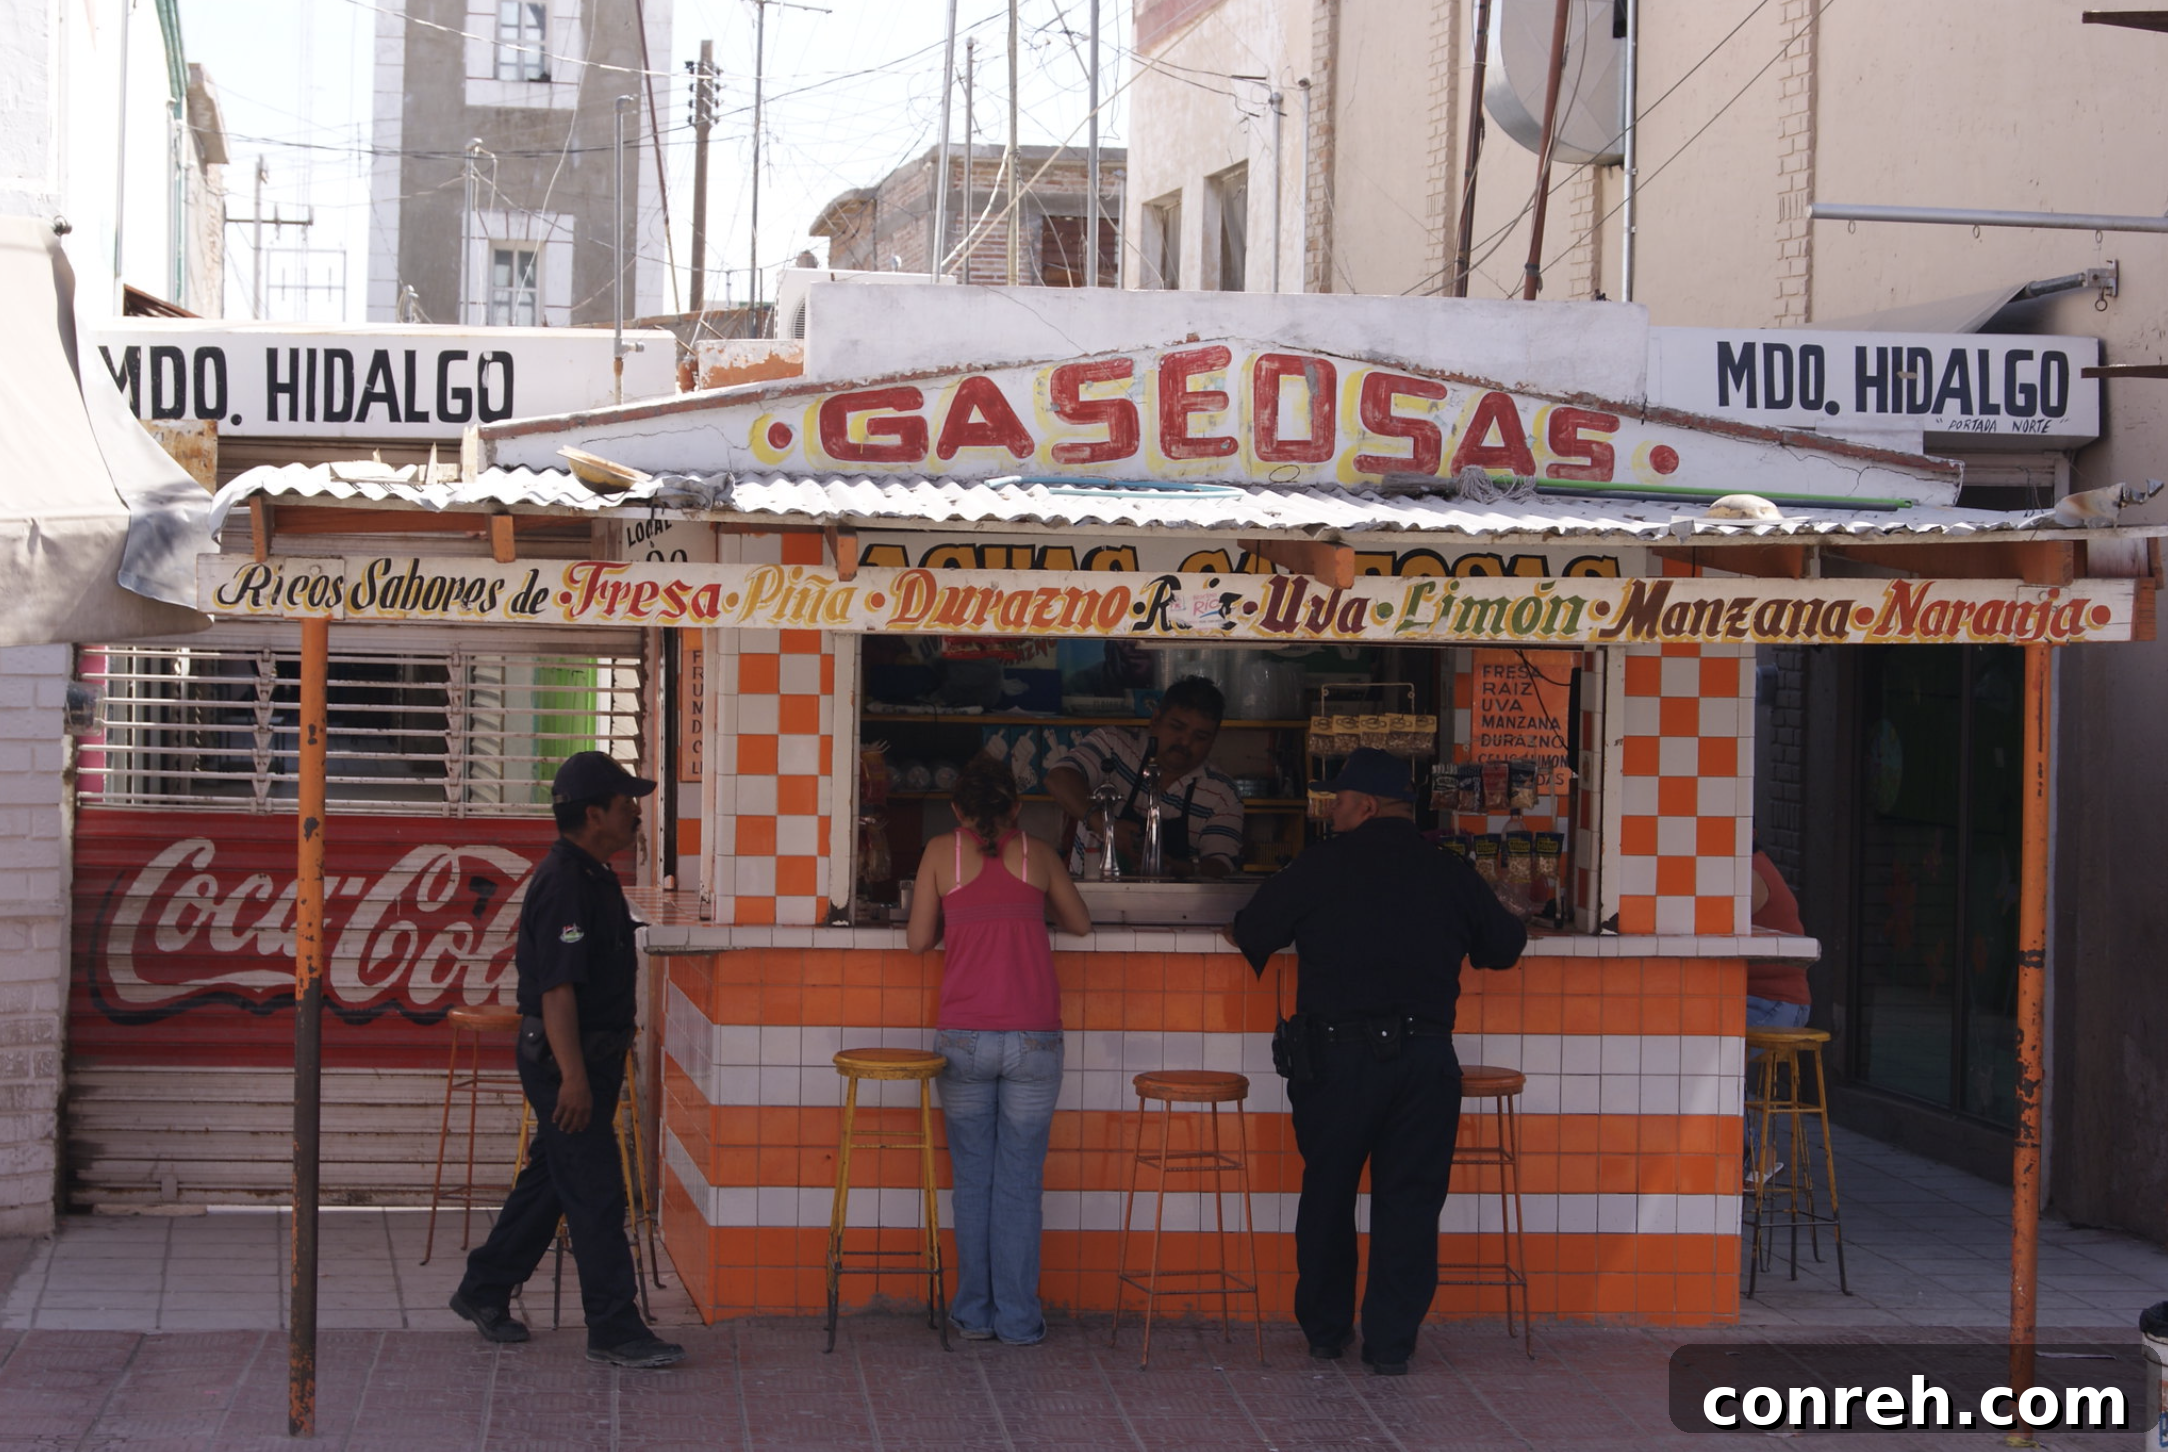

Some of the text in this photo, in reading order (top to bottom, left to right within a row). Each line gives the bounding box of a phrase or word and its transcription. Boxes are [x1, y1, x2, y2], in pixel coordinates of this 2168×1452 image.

[266, 347, 515, 422] HIDALGO
[1717, 341, 2069, 418] MDO. HIDALGO
[819, 345, 1620, 483] GASEOSAS
[627, 520, 672, 548] LOCAL
[217, 561, 343, 608] Ricos
[350, 558, 505, 612] Sabores
[511, 568, 549, 615] de
[569, 561, 722, 619] Fresa
[736, 564, 858, 624] Piña
[886, 570, 1131, 631] Durazno
[1257, 574, 1372, 635] Uva
[1395, 581, 1589, 636] Limón
[1598, 579, 1858, 639] Manzana
[1872, 579, 2092, 642] Naranja
[1482, 664, 1543, 679] FRESA
[1482, 682, 1533, 696] RAIZ
[1481, 699, 1523, 713] UVA
[1481, 715, 1561, 731] MANZANA
[1480, 733, 1564, 749] DURAZNO
